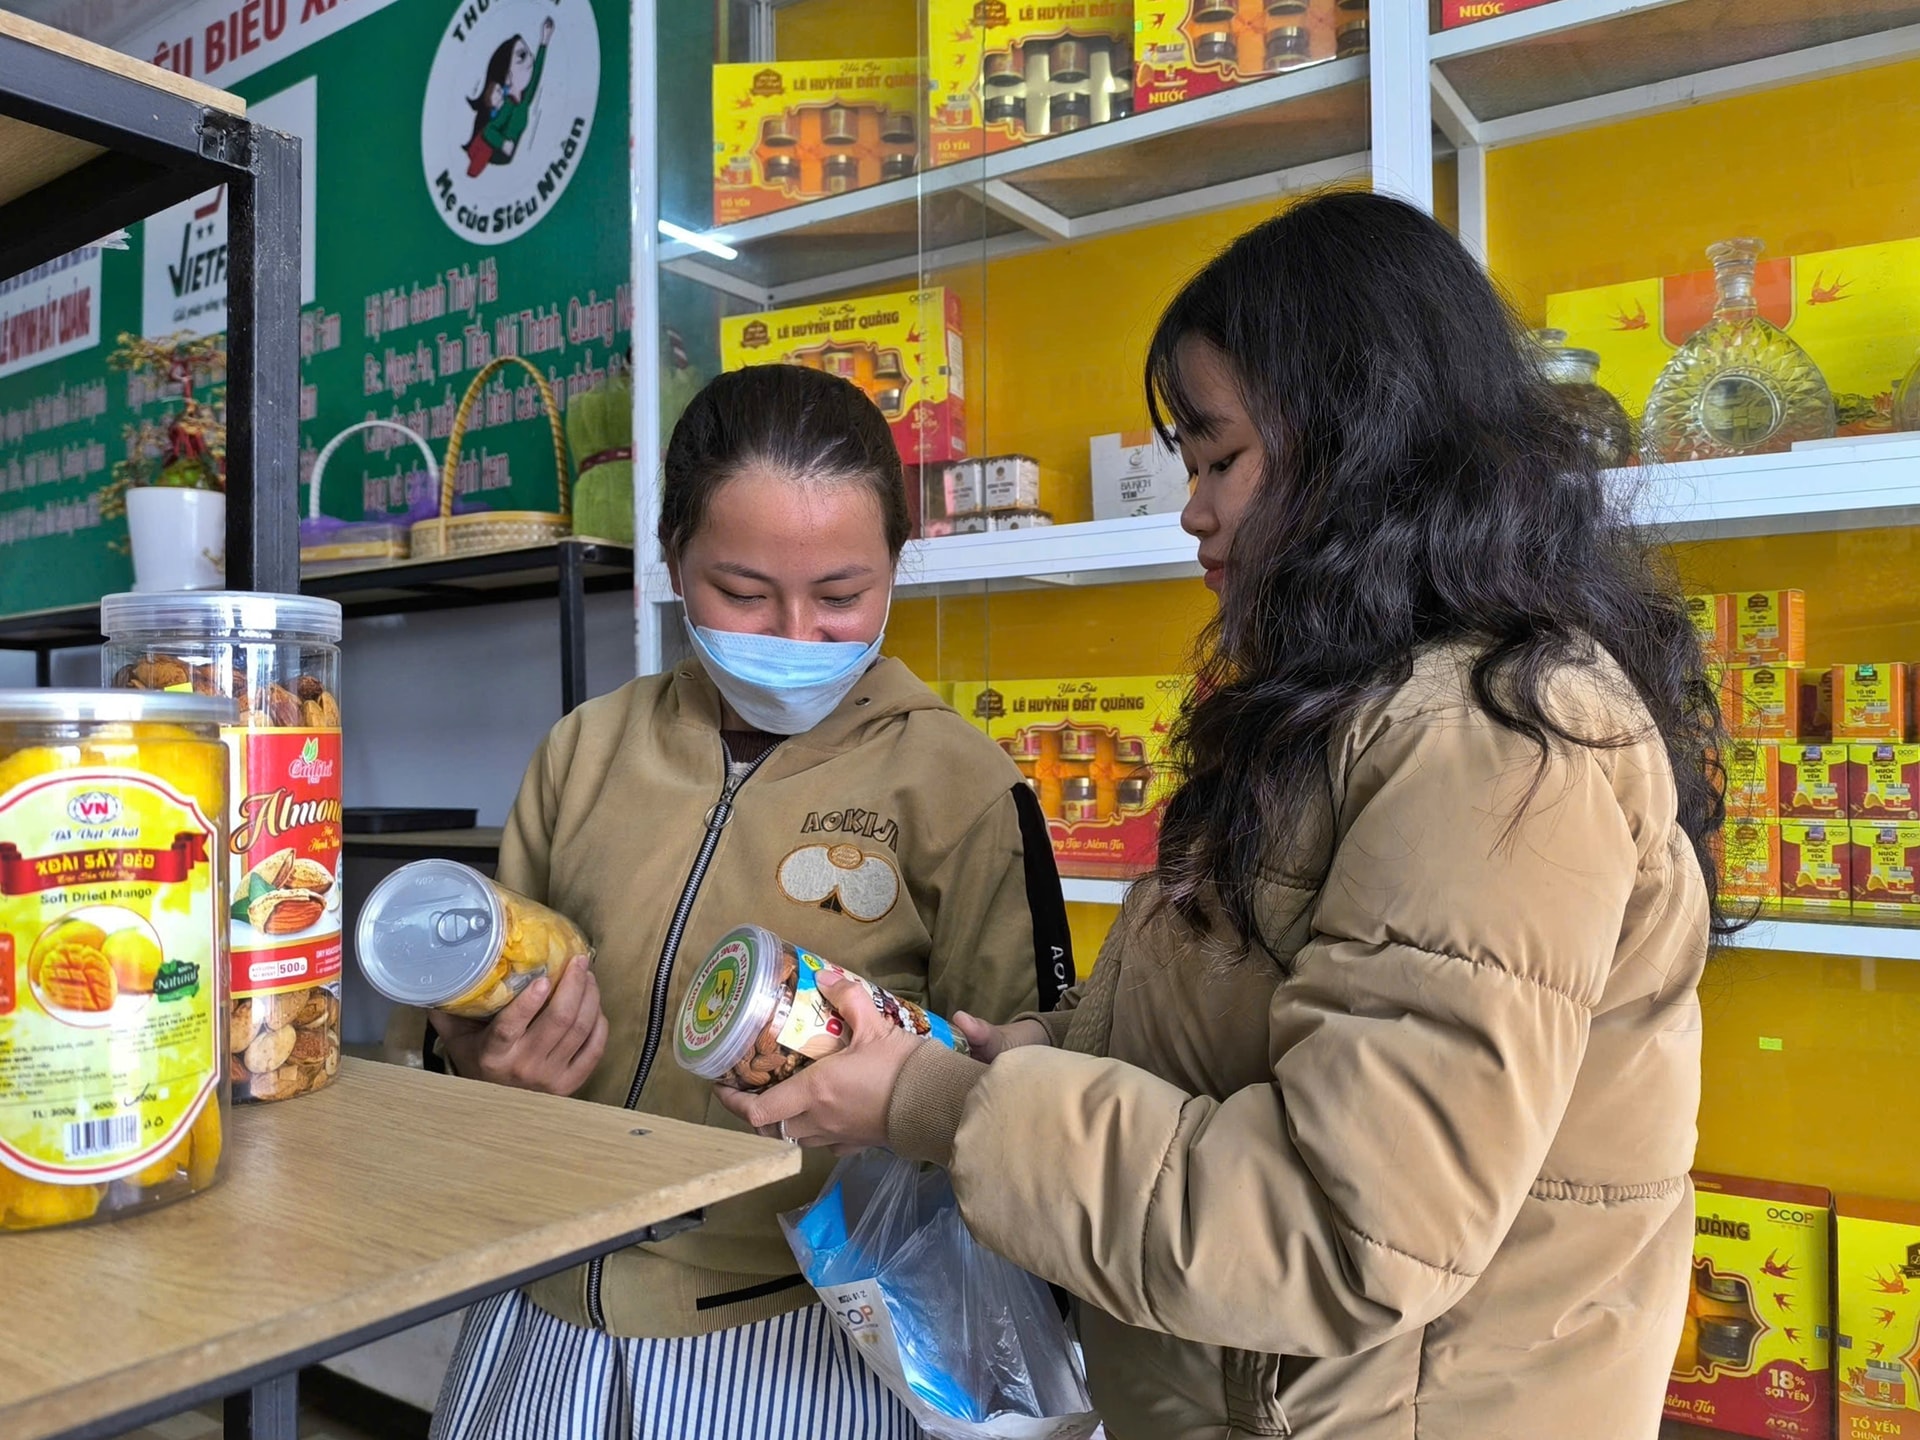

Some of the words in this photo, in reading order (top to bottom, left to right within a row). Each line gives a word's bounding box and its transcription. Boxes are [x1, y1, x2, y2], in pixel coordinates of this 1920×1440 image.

[457, 204, 490, 234] của
[493, 196, 538, 234] Siêu
[537, 116, 586, 202] Nhân
[168, 222, 228, 298] VIETF
[777, 325, 790, 339] LÊ
[792, 318, 830, 336] HUỲNH
[859, 309, 899, 328] QUẢNG
[1013, 698, 1026, 713] LÊ
[1029, 695, 1069, 713] HUỲNH
[1100, 693, 1145, 711] QUẢNG
[80, 802, 108, 816] VN
[229, 787, 342, 855] Almon
[35, 855, 79, 876] XOÀI
[84, 849, 117, 869] SẤY
[41, 893, 68, 904] Soft
[72, 890, 107, 902] Dried
[110, 887, 152, 899] Mango
[157, 971, 198, 990] Natural
[1767, 1207, 1815, 1224] OCOP
[1694, 1213, 1751, 1241] UẢNG
[1765, 1386, 1784, 1398] SỢI
[1786, 1389, 1810, 1403] YẾN
[1850, 1414, 1871, 1430] TỔ
[1874, 1419, 1902, 1435] YẾN
